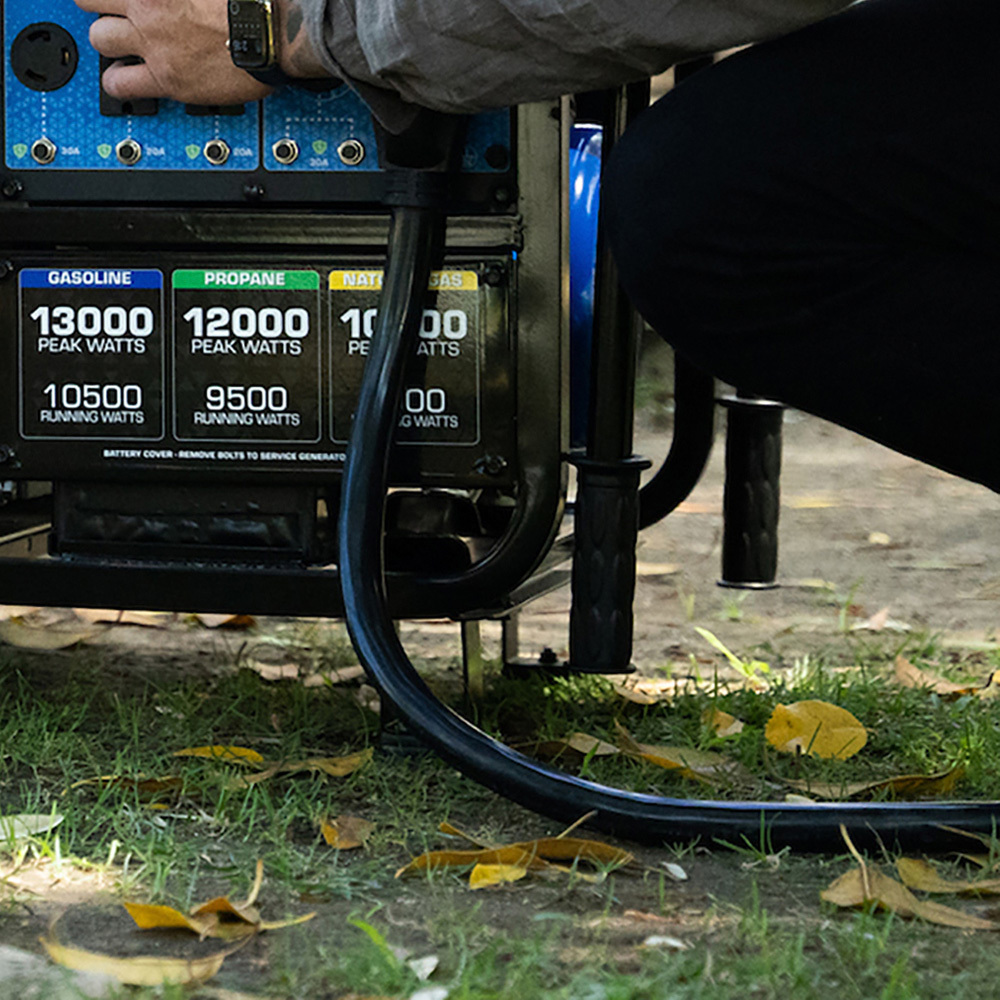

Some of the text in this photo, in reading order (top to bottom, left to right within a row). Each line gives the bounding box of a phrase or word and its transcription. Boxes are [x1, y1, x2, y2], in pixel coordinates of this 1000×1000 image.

[48, 271, 132, 285] GASOLINE
[204, 272, 285, 285] PROPANE
[429, 273, 463, 287] GAS
[30, 306, 154, 337] 13000
[183, 307, 309, 338] 12000
[340, 308, 467, 339] 1000
[38, 338, 146, 353] PEAK WATTS
[191, 339, 302, 355] PEAK WATTS
[417, 341, 460, 356] ATTS
[43, 384, 142, 409] 10500
[206, 385, 287, 411] 9500
[40, 410, 144, 424] RUNNING WATTS
[194, 412, 300, 426] RUNNING WATTS
[413, 415, 459, 428] WATTS
[103, 450, 141, 458] BATTERY
[143, 450, 173, 458] COVER
[178, 451, 216, 459] REMOVE
[217, 451, 245, 460] BOLTS
[247, 452, 258, 460] TO
[260, 452, 297, 460] SERVICE
[298, 453, 346, 461] GENERATO
